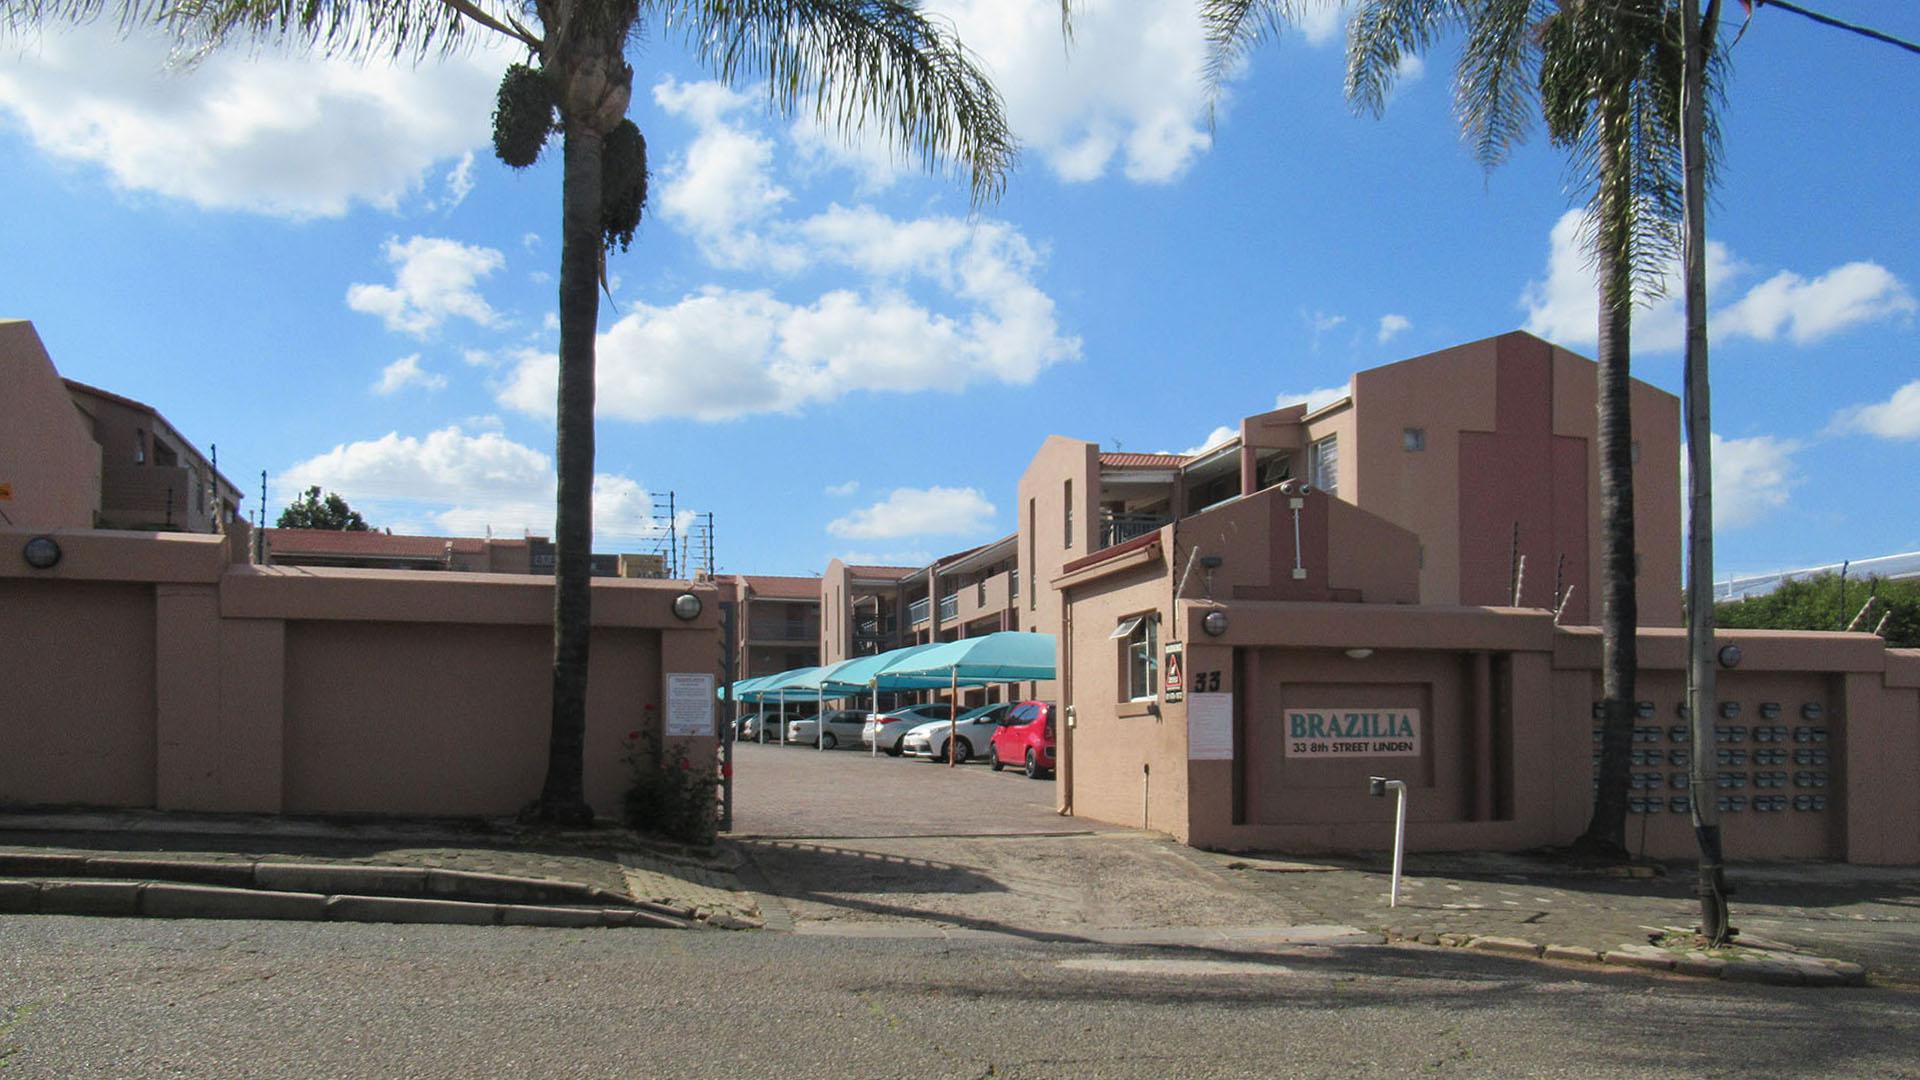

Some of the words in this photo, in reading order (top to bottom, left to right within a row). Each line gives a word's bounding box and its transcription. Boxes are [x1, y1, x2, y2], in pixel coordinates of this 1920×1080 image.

[1195, 671, 1221, 692] 33
[1290, 713, 1414, 737] BRAZILIA
[1293, 743, 1306, 753] 33
[1310, 742, 1328, 753] 8th
[1332, 742, 1369, 752] STREET
[1373, 741, 1412, 752] LINDEN
